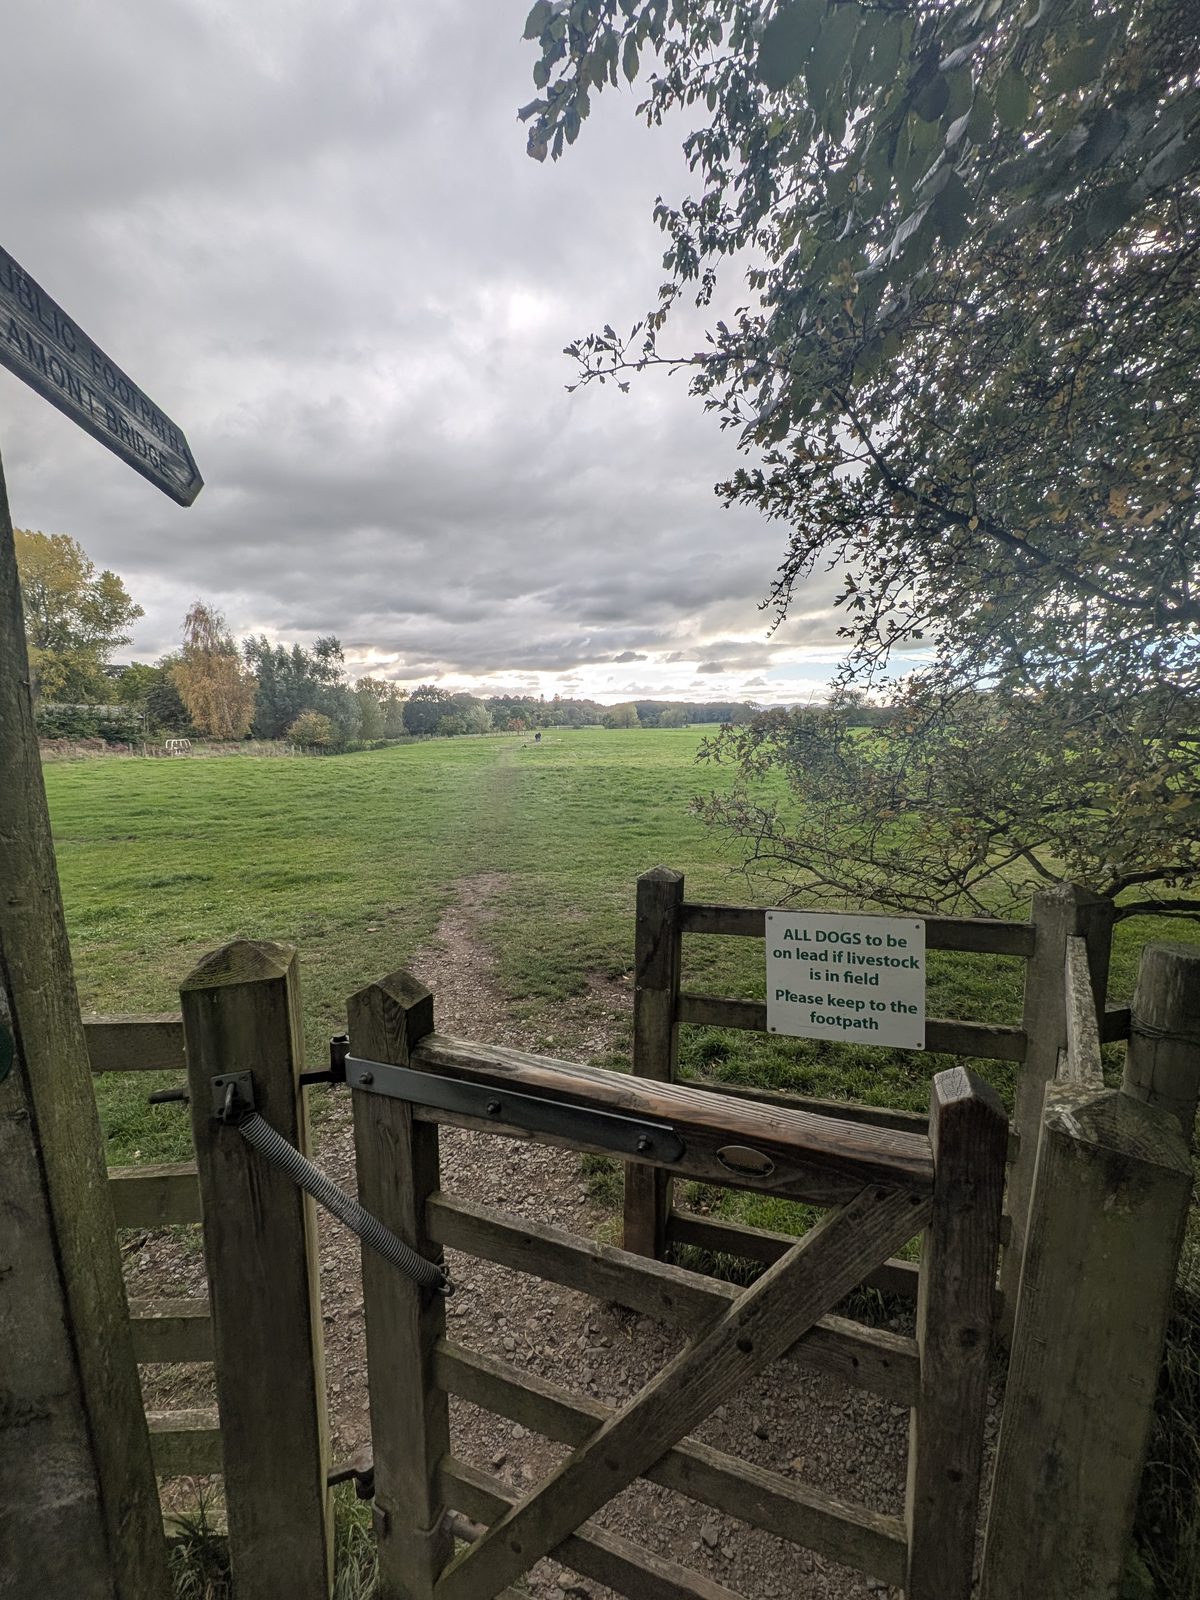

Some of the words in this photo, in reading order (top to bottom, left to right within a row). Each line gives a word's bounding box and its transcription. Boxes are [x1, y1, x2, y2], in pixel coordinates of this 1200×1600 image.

[0, 317, 95, 415] AMONT
[104, 404, 169, 477] BRIDGE
[91, 347, 179, 451] FOOTPATH
[783, 928, 812, 942] ALL
[815, 930, 862, 945] DOGS
[865, 934, 883, 947] to
[886, 934, 908, 948] be
[773, 949, 792, 960] on
[796, 948, 828, 962] lead
[832, 950, 844, 963] if
[847, 951, 920, 969] livestock
[809, 968, 822, 980] is
[825, 969, 840, 983] in
[843, 971, 879, 986] field
[775, 989, 824, 1005] Please
[827, 993, 866, 1012] keep
[869, 999, 886, 1012] to
[890, 1000, 918, 1014] the
[809, 1011, 879, 1030] footpath
